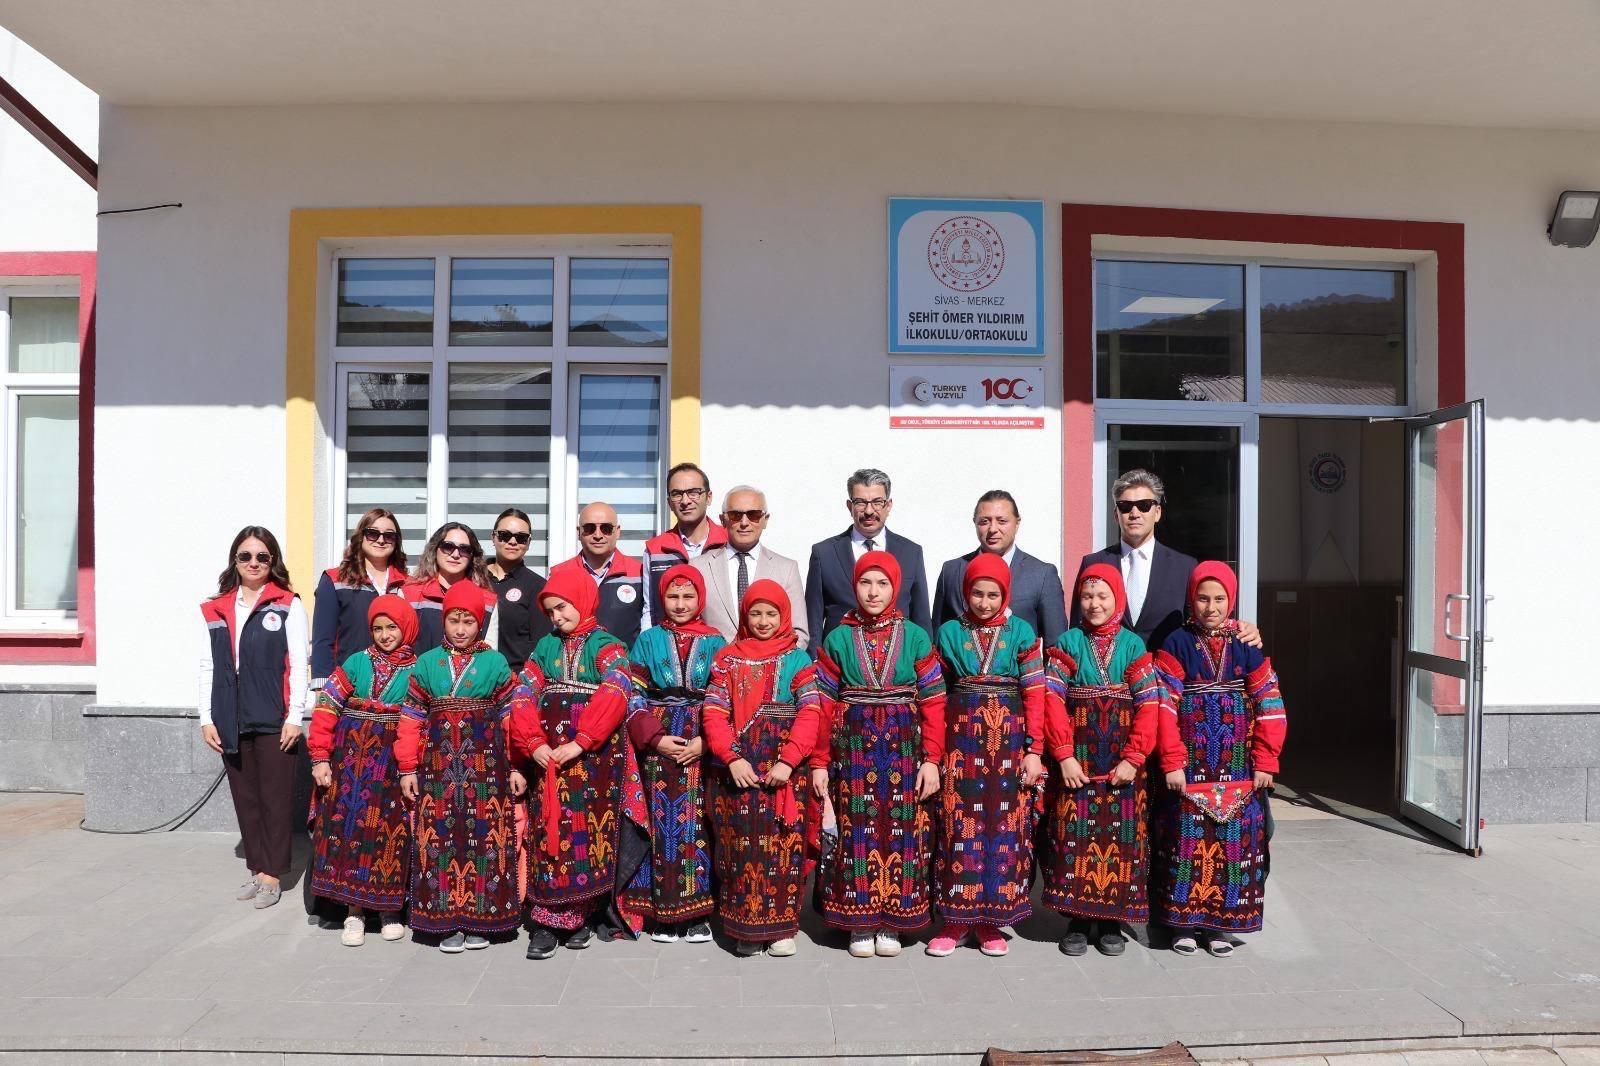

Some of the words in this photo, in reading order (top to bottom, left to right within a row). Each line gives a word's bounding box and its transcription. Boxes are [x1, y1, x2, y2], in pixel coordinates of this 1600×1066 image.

[934, 293, 960, 306] SİVAS
[967, 296, 1005, 306] MERKEZ
[908, 309, 939, 326] ŞEHİT
[942, 310, 974, 324] ÖMER
[976, 313, 1025, 325] YILDIRIM
[906, 326, 1028, 342] İLKOKULU/ORTAOKULU
